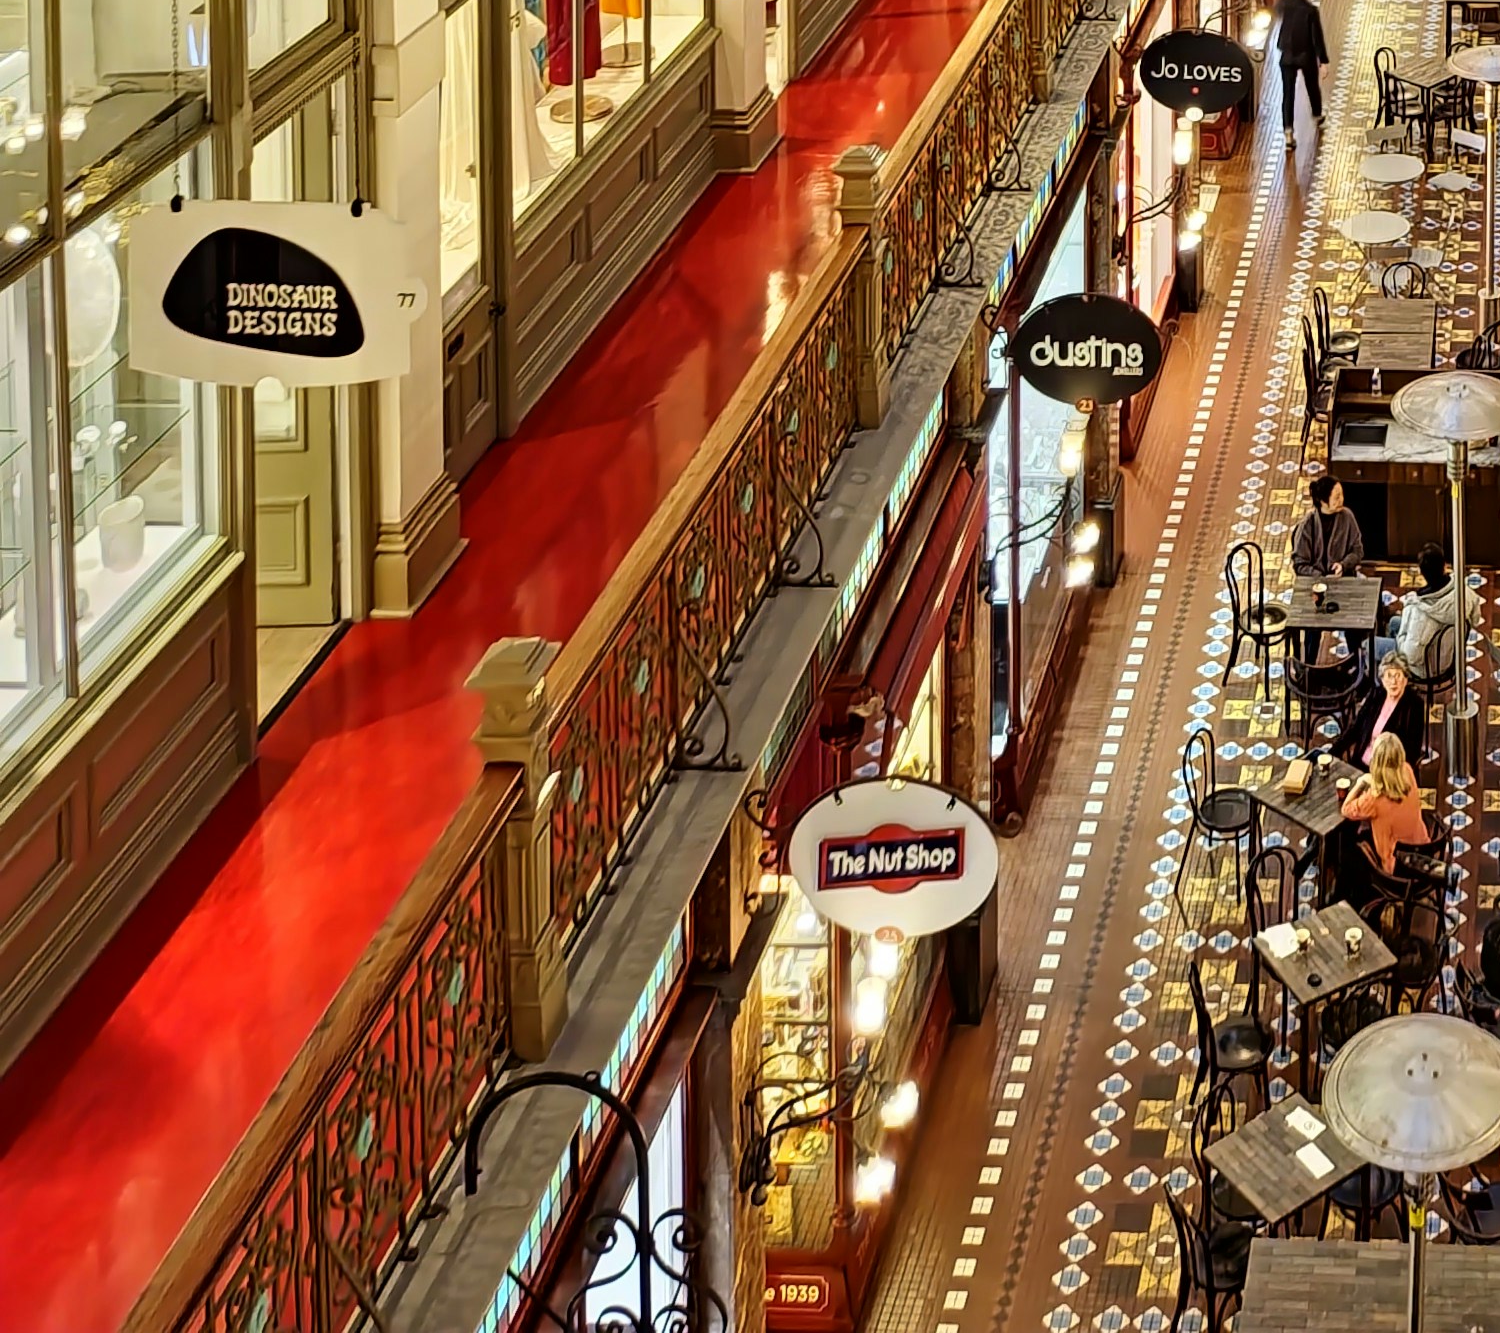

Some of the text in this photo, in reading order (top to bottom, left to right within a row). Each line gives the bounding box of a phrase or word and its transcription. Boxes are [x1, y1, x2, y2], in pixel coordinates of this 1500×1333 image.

[1183, 64, 1242, 83] LOVES
[225, 283, 338, 309] DINOSAUR
[396, 292, 416, 308] 77
[226, 310, 338, 337] DESIGNS
[1029, 334, 1144, 367] dustins
[828, 843, 956, 877] The Nut Shop
[779, 1283, 820, 1303] 1939
